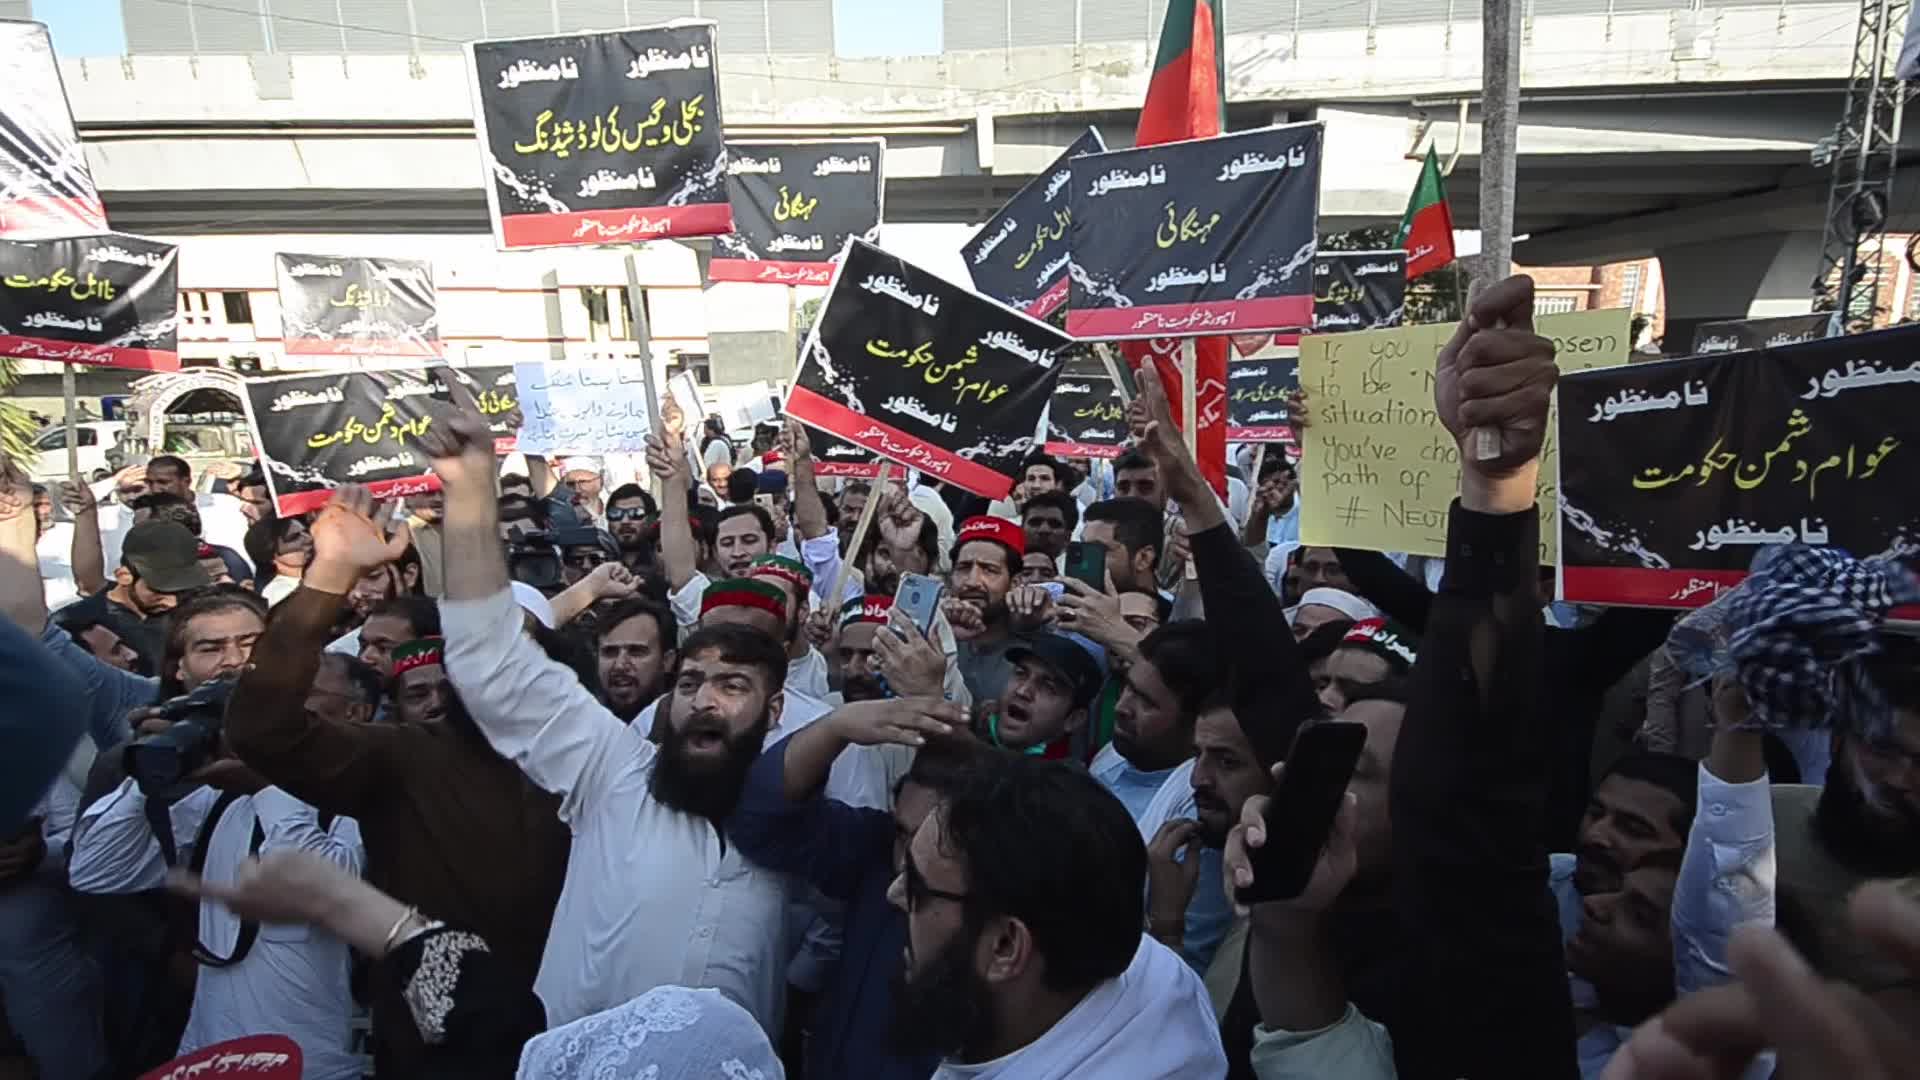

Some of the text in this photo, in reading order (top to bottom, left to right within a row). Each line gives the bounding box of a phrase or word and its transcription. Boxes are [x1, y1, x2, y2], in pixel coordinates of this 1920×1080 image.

[497, 57, 579, 88] نامنظور
[626, 46, 710, 79] نامنظور
[674, 95, 704, 145] بجلی
[725, 157, 781, 176] نامنظور
[813, 156, 871, 176] نامنظور
[1215, 146, 1305, 181] نامنظور
[575, 167, 656, 198] نامنظور
[1044, 169, 1071, 202] نظور
[1087, 164, 1166, 196] نامنظور
[974, 217, 1018, 264] نامنظور
[1156, 201, 1221, 248] مہنگائی
[766, 234, 824, 252] نامنظور
[4, 268, 75, 292] حکومت
[1144, 262, 1226, 292] نامنظور
[859, 274, 940, 317] نامنظور
[20, 311, 103, 332] نامنظور
[866, 340, 935, 368] حکومت
[978, 330, 1055, 369] نامنظور
[1551, 335, 1617, 354] osen
[1362, 371, 1391, 394] be
[1801, 358, 1920, 399] منظور
[270, 386, 344, 412] نامنظور
[880, 393, 958, 433] نامنظور
[1588, 380, 1709, 422] نامنظور
[307, 416, 365, 447] حکومت
[346, 452, 414, 476] نامنظور
[1322, 435, 1458, 471] you've cho
[1632, 437, 1737, 489] حکومت
[1322, 464, 1430, 500] path of
[1688, 517, 1829, 550] نامنظور
